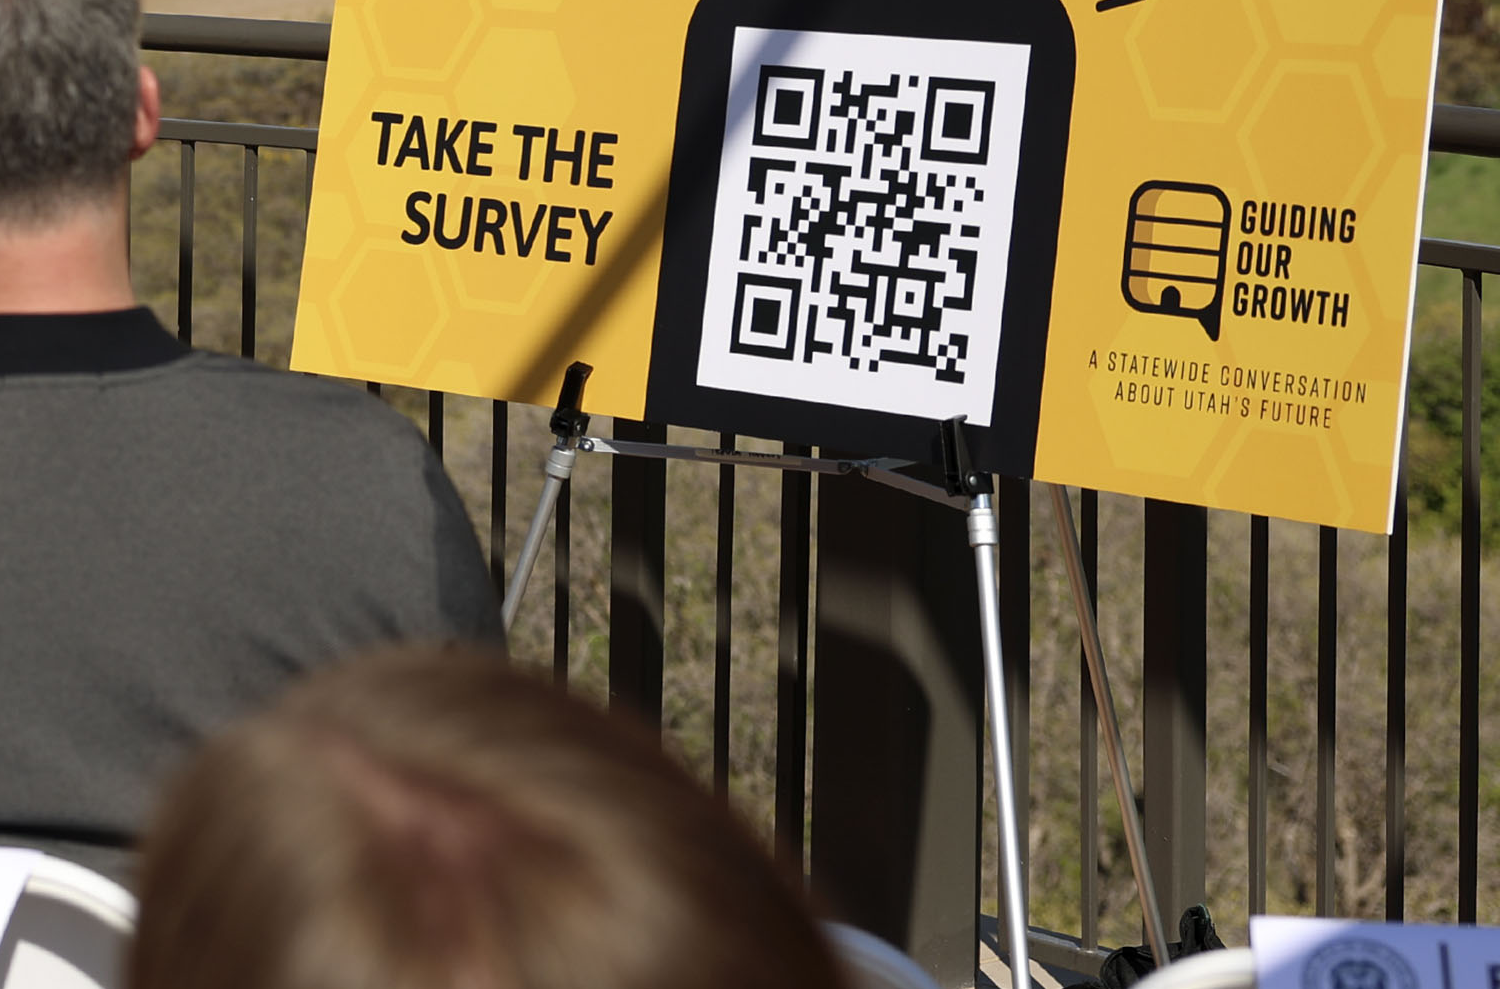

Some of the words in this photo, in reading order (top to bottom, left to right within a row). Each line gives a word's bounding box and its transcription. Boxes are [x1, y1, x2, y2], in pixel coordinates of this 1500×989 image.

[371, 111, 498, 177] TAKE
[513, 124, 618, 189] THE
[401, 191, 613, 266] SURVEY
[1240, 200, 1357, 244] GUIDING
[1236, 240, 1292, 280] OUR
[1232, 281, 1350, 328] GROWTH
[1088, 349, 1098, 370] A
[1107, 351, 1211, 384] STATEWIDE
[1220, 365, 1367, 404] CONVERSATION
[1114, 380, 1175, 408] ABOUT
[1184, 389, 1251, 418] UTAH'S
[1259, 398, 1333, 429] FUTURE
